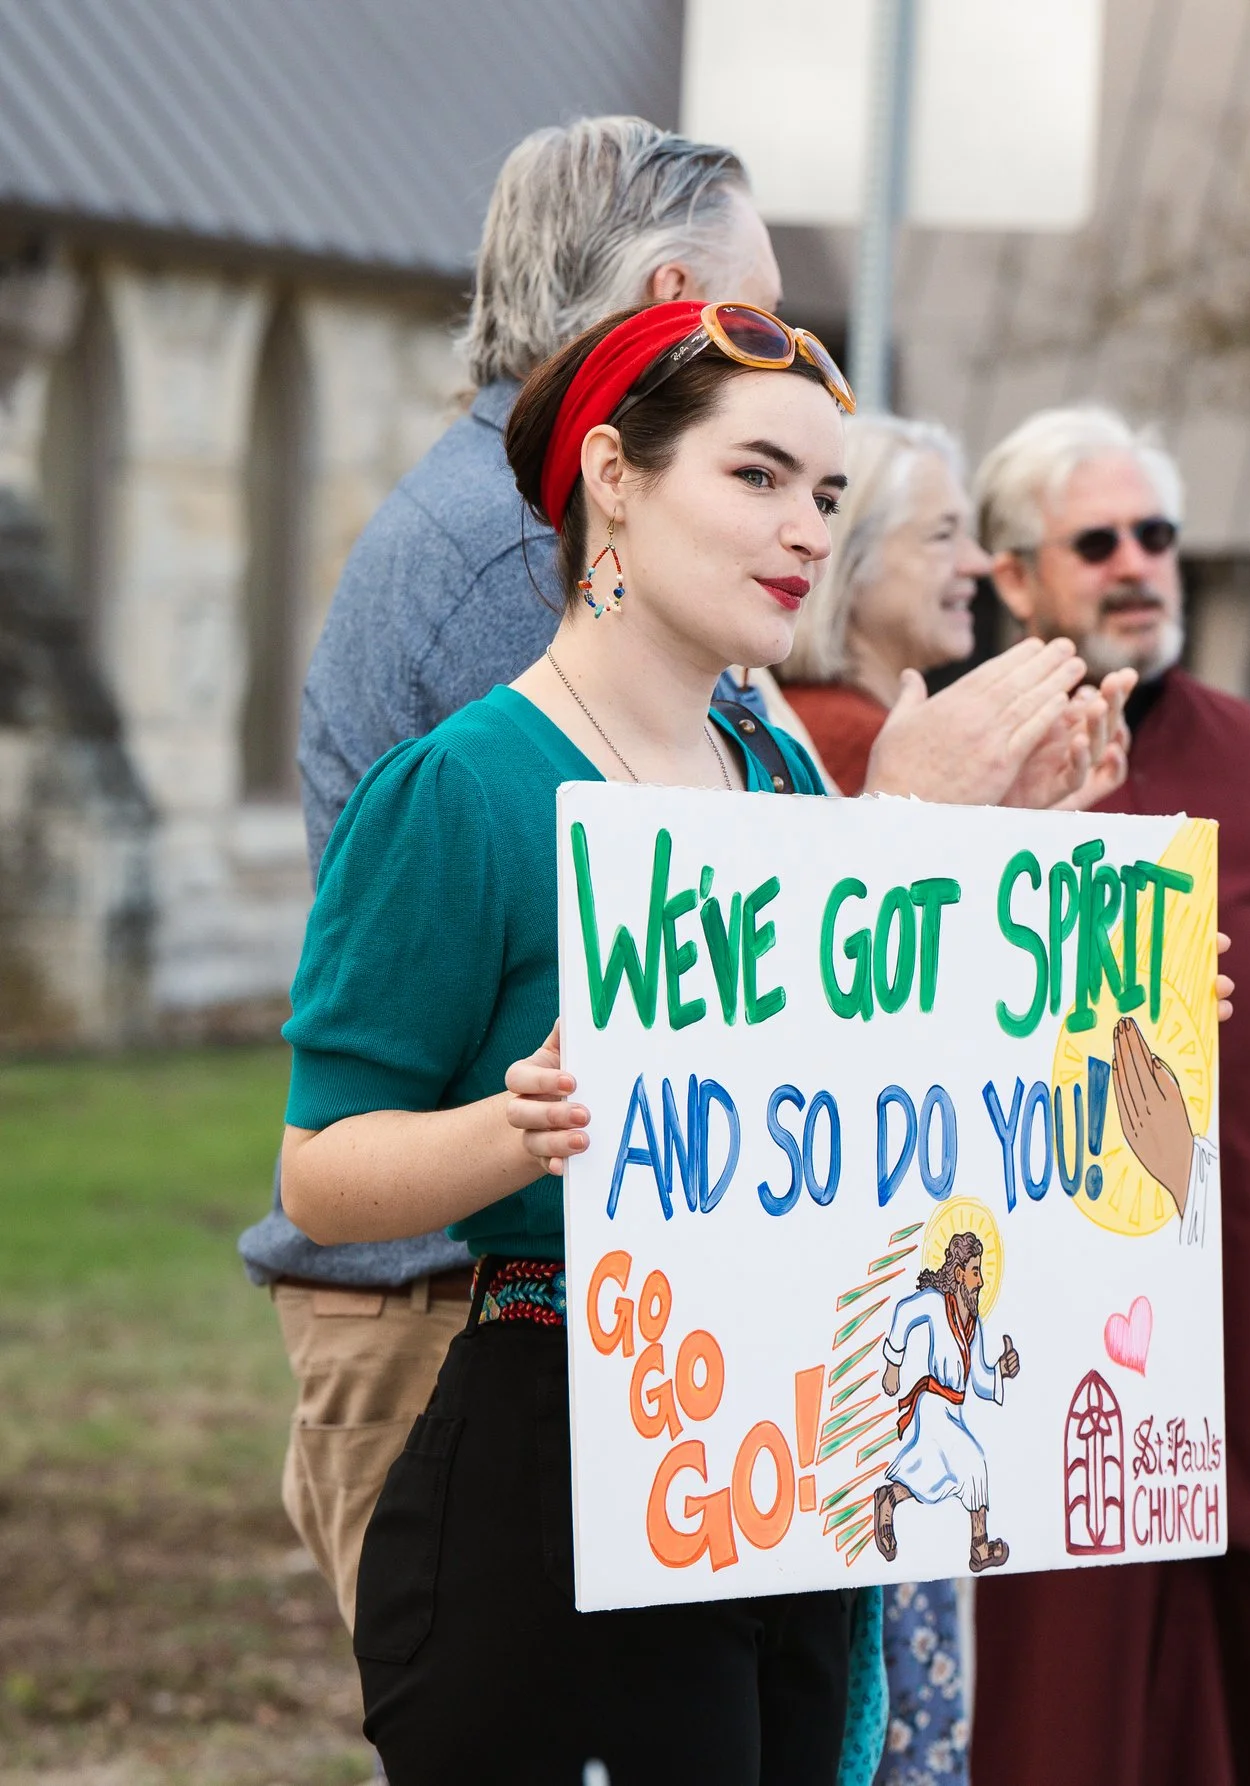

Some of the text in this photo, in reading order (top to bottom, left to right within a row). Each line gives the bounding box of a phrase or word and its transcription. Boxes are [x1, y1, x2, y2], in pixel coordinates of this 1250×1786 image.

[570, 820, 1194, 1039] WE'VE GOT SPIRIT
[605, 1056, 1112, 1222] AND SO DO YOU!
[629, 1329, 726, 1442] GO
[1166, 1416, 1223, 1477] Paul's
[646, 1363, 826, 1574] GO!
[1131, 1482, 1220, 1547] CHURCH
